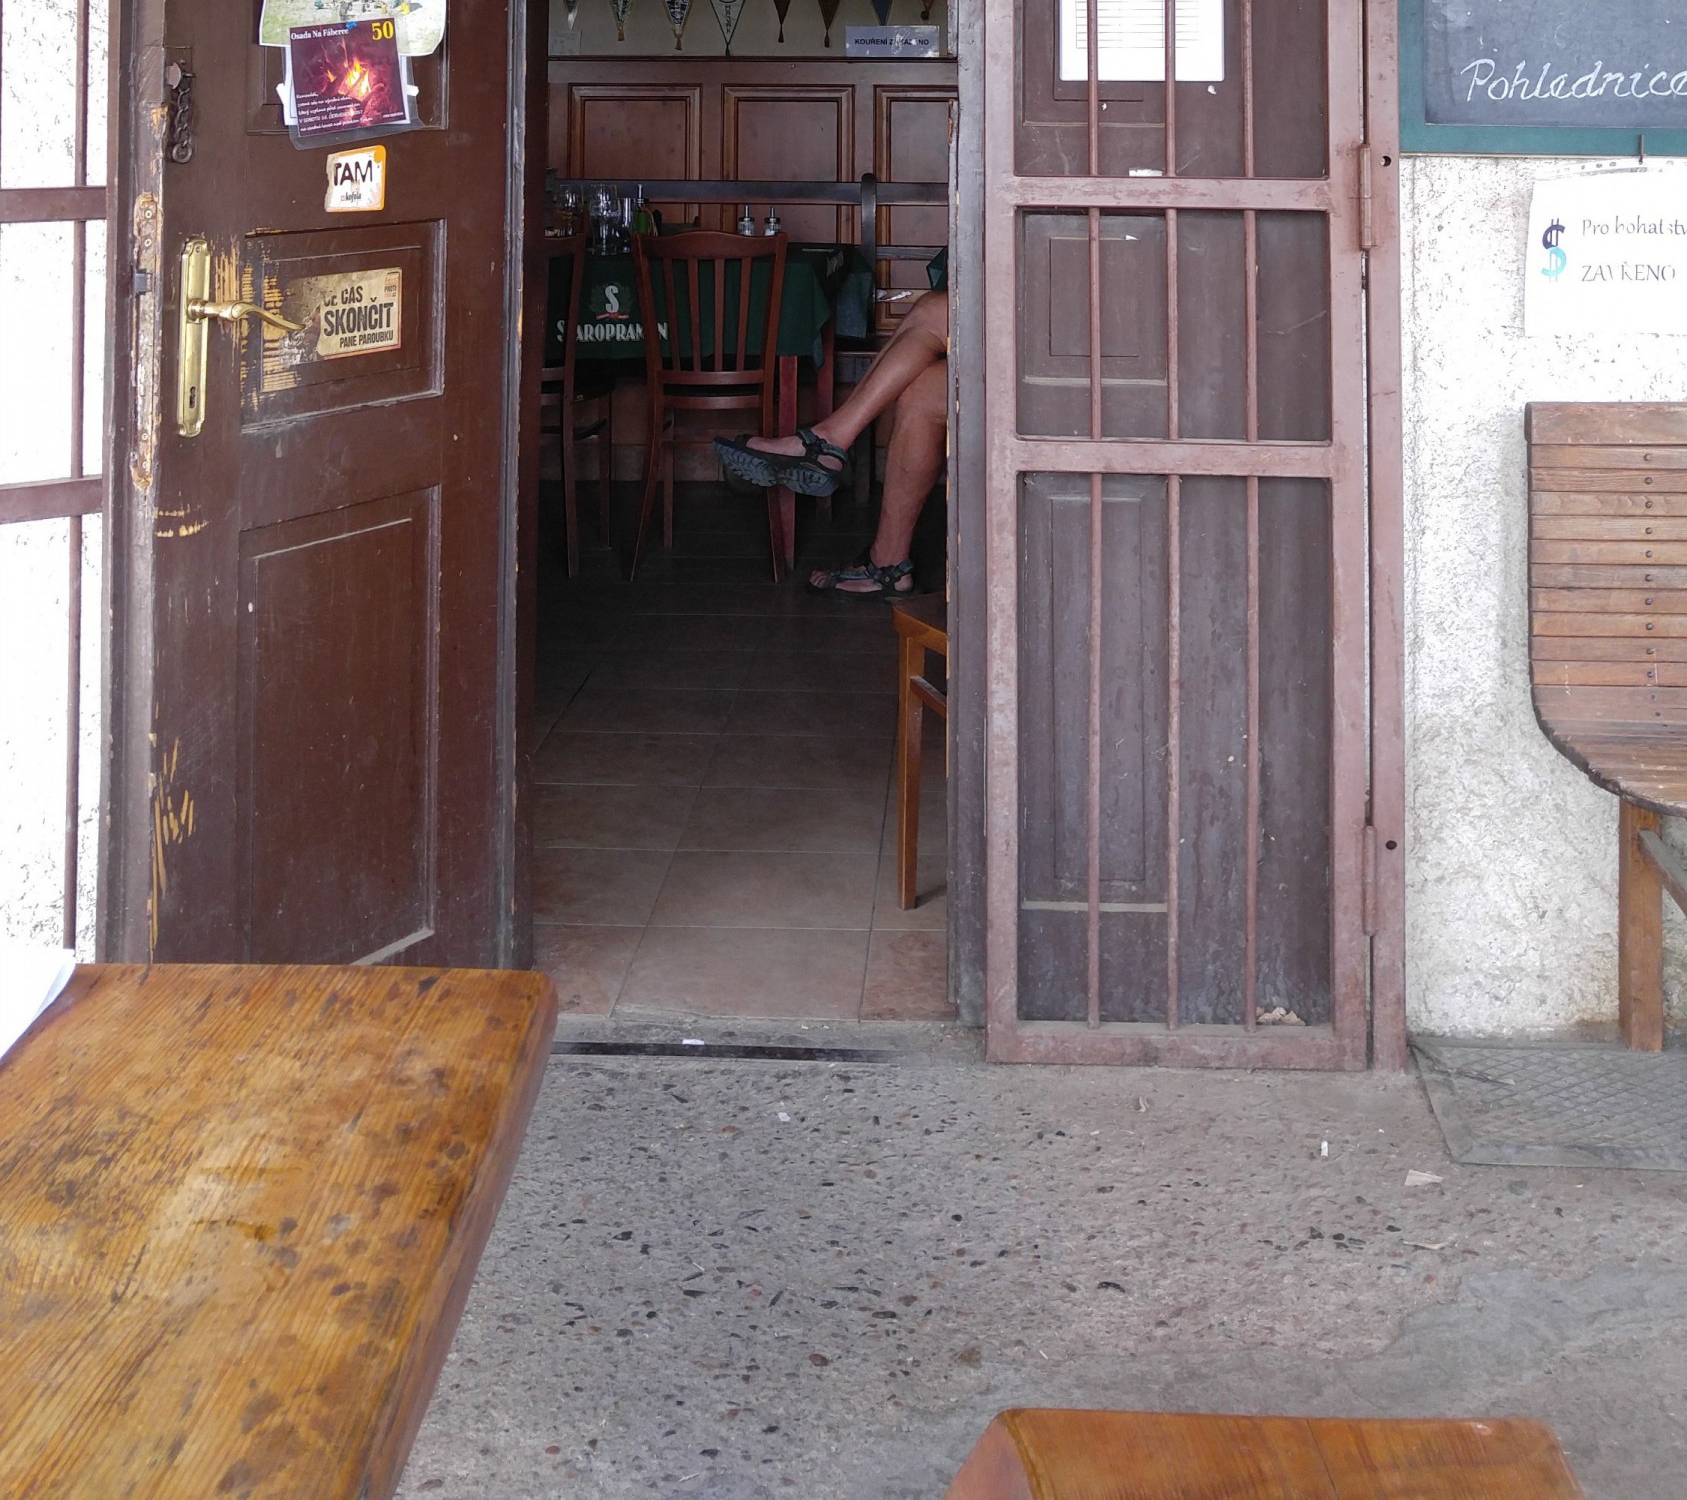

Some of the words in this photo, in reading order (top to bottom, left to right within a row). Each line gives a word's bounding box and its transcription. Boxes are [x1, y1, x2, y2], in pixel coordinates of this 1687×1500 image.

[290, 30, 312, 41] Osada
[312, 30, 322, 38] Na
[371, 20, 394, 41] 50
[854, 37, 888, 46] KOUŘENÍ
[333, 159, 373, 187] TAM
[1582, 219, 1610, 236] Pro
[605, 285, 620, 313] S
[323, 296, 394, 337] SKONČIT
[339, 335, 357, 349] PANE
[358, 330, 394, 346] PAROUBKU
